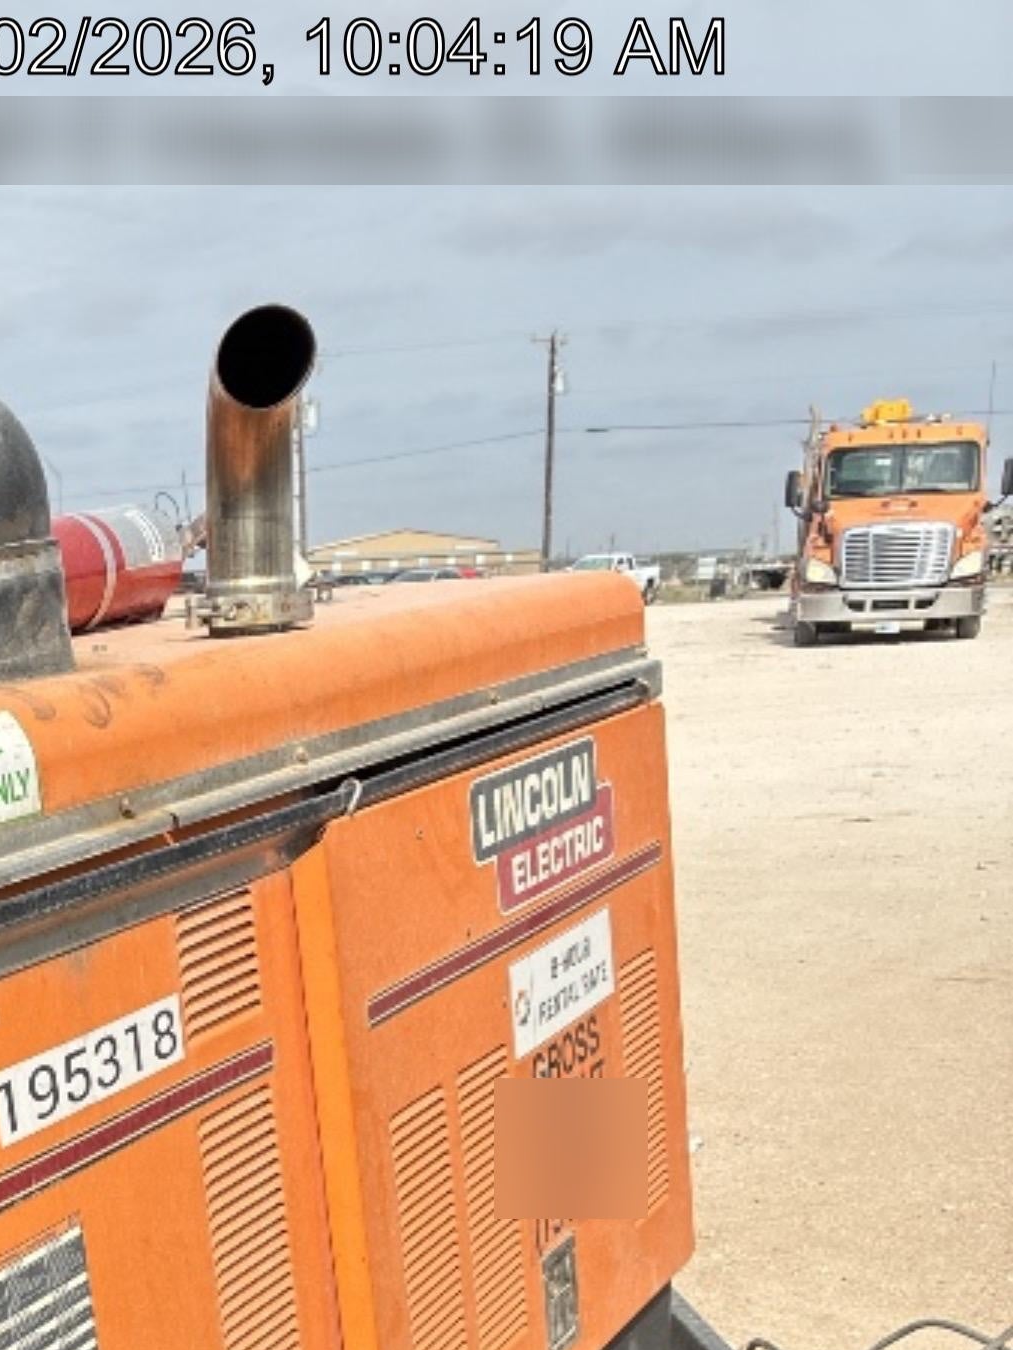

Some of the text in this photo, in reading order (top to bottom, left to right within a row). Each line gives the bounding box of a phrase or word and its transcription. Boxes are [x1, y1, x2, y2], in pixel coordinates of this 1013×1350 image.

[477, 751, 592, 849] LINCOLN
[510, 815, 605, 895] ELECTRIC
[533, 1014, 600, 1079] GROSS
